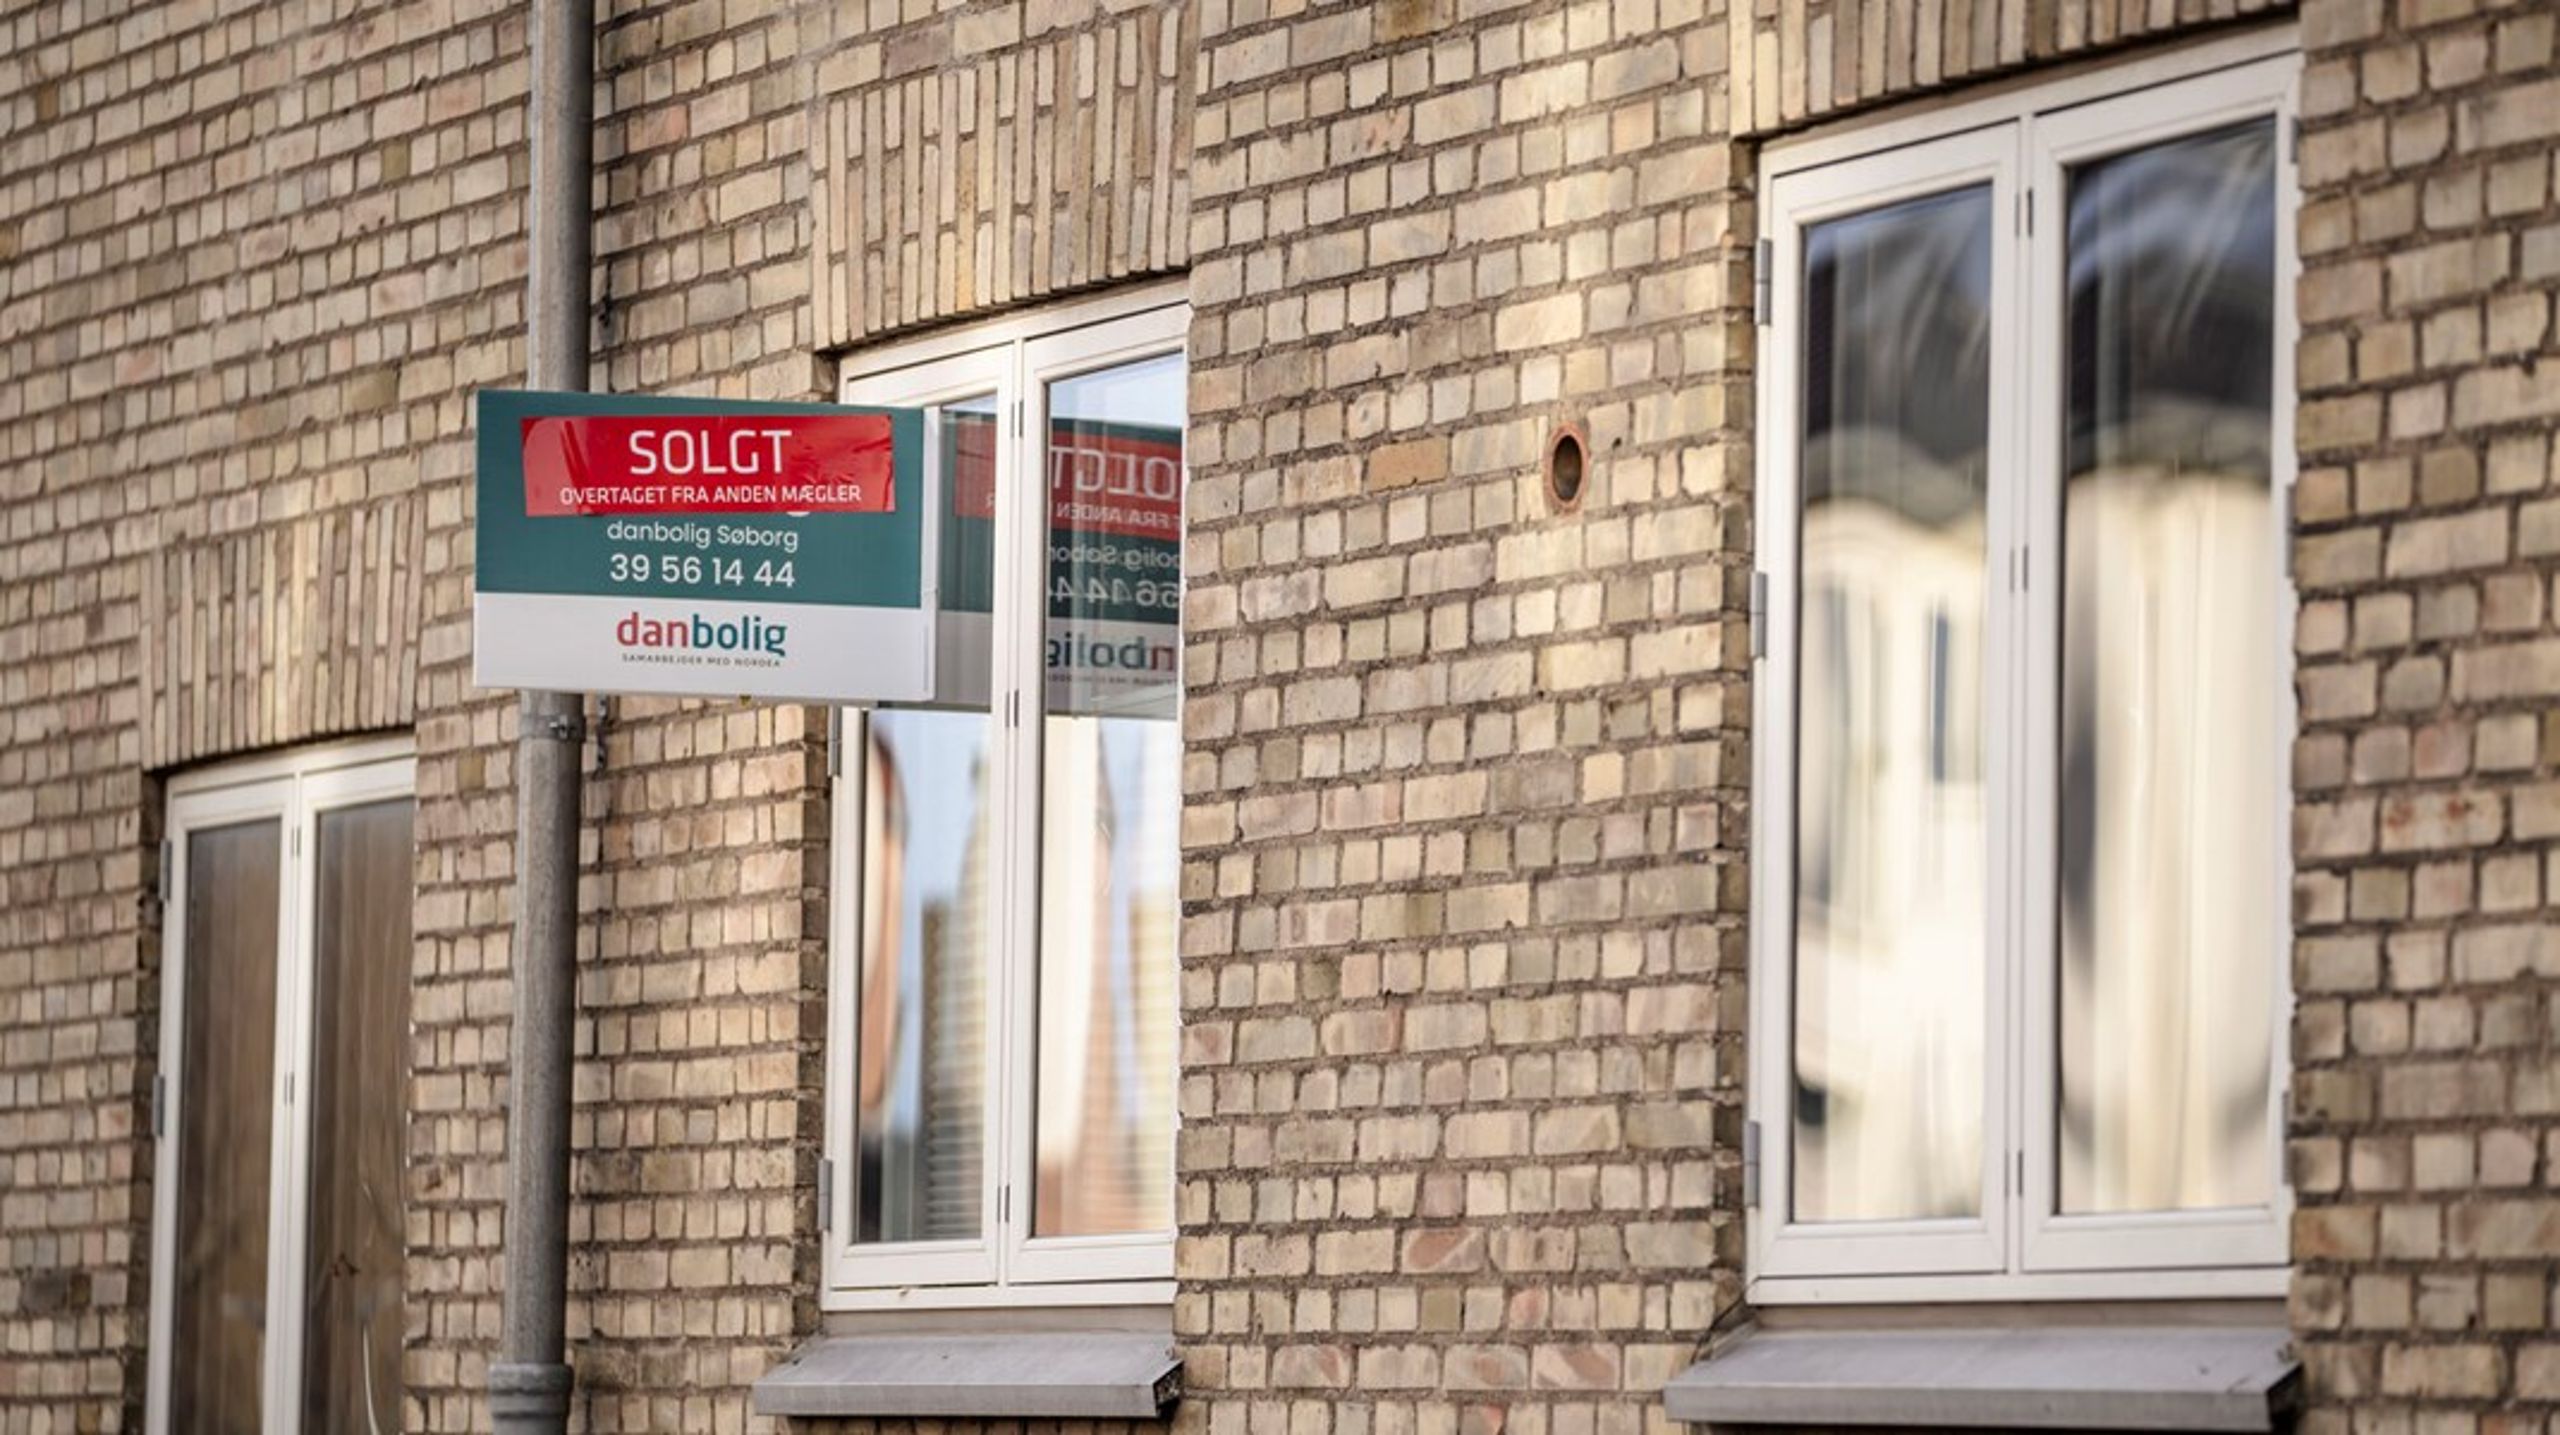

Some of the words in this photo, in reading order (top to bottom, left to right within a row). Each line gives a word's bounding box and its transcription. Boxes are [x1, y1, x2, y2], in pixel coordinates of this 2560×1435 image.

[629, 429, 793, 475] SOLGT
[560, 486, 667, 505] OVERTAGET
[671, 486, 709, 503] FRA
[712, 485, 776, 503] ANDEN
[781, 484, 862, 502] MÆGLER
[607, 519, 711, 549] danbolig
[716, 524, 799, 553] Søborg
[610, 553, 650, 582] 39
[661, 555, 702, 584] 56
[711, 556, 744, 586] 14
[753, 559, 796, 588] 44
[616, 611, 787, 657] danbolig
